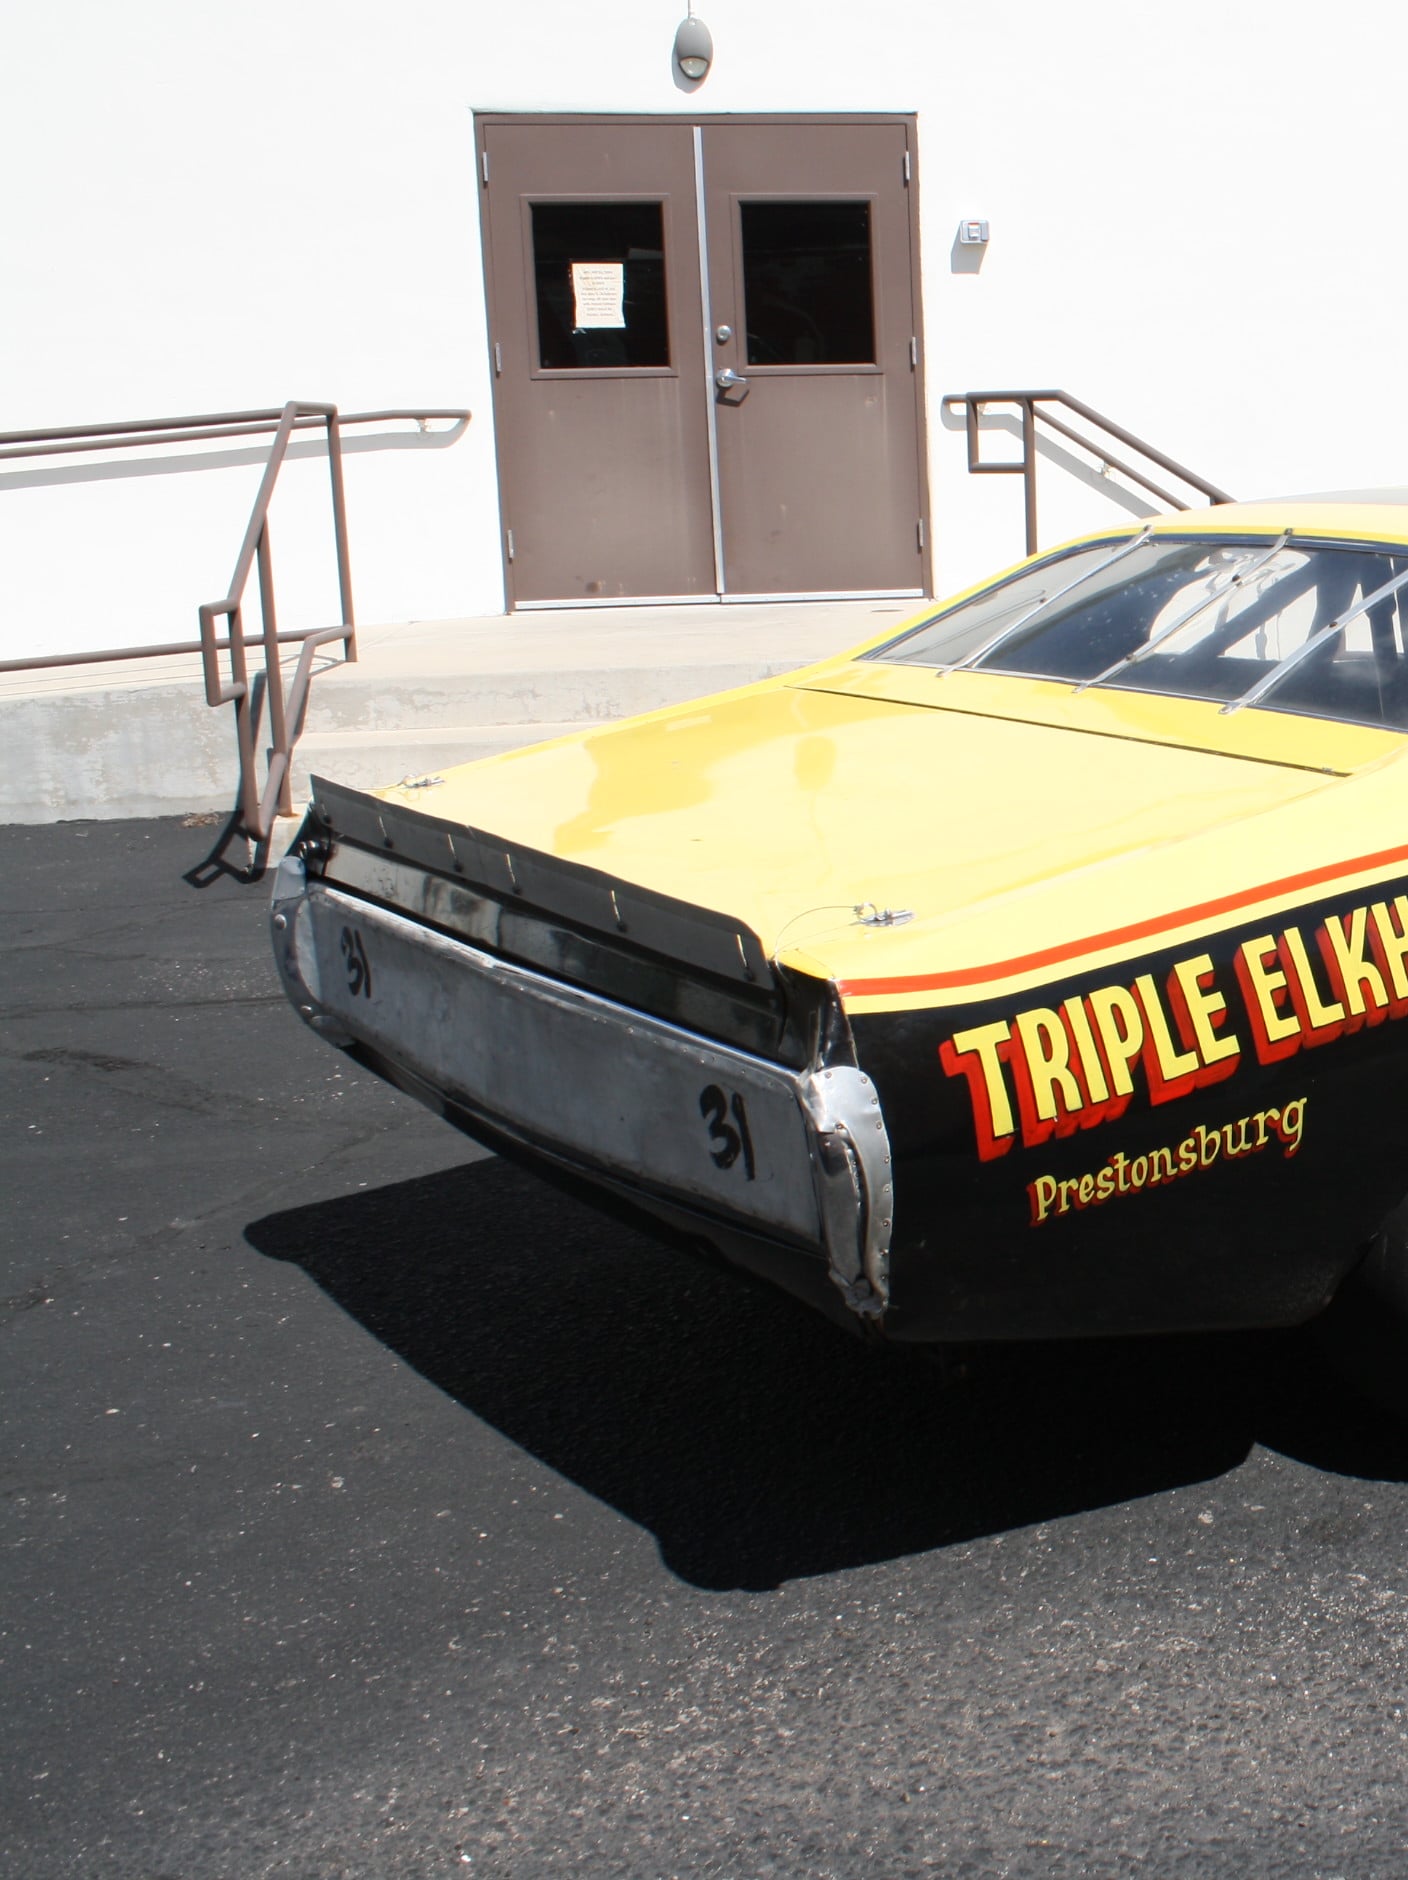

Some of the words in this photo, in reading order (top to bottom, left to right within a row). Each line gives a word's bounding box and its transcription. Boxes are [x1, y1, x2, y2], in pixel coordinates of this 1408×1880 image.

[340, 926, 372, 999] 31
[938, 952, 1242, 1163] TRIPLE
[699, 1083, 757, 1182] 31
[1028, 1096, 1308, 1226] Prestonsburg
